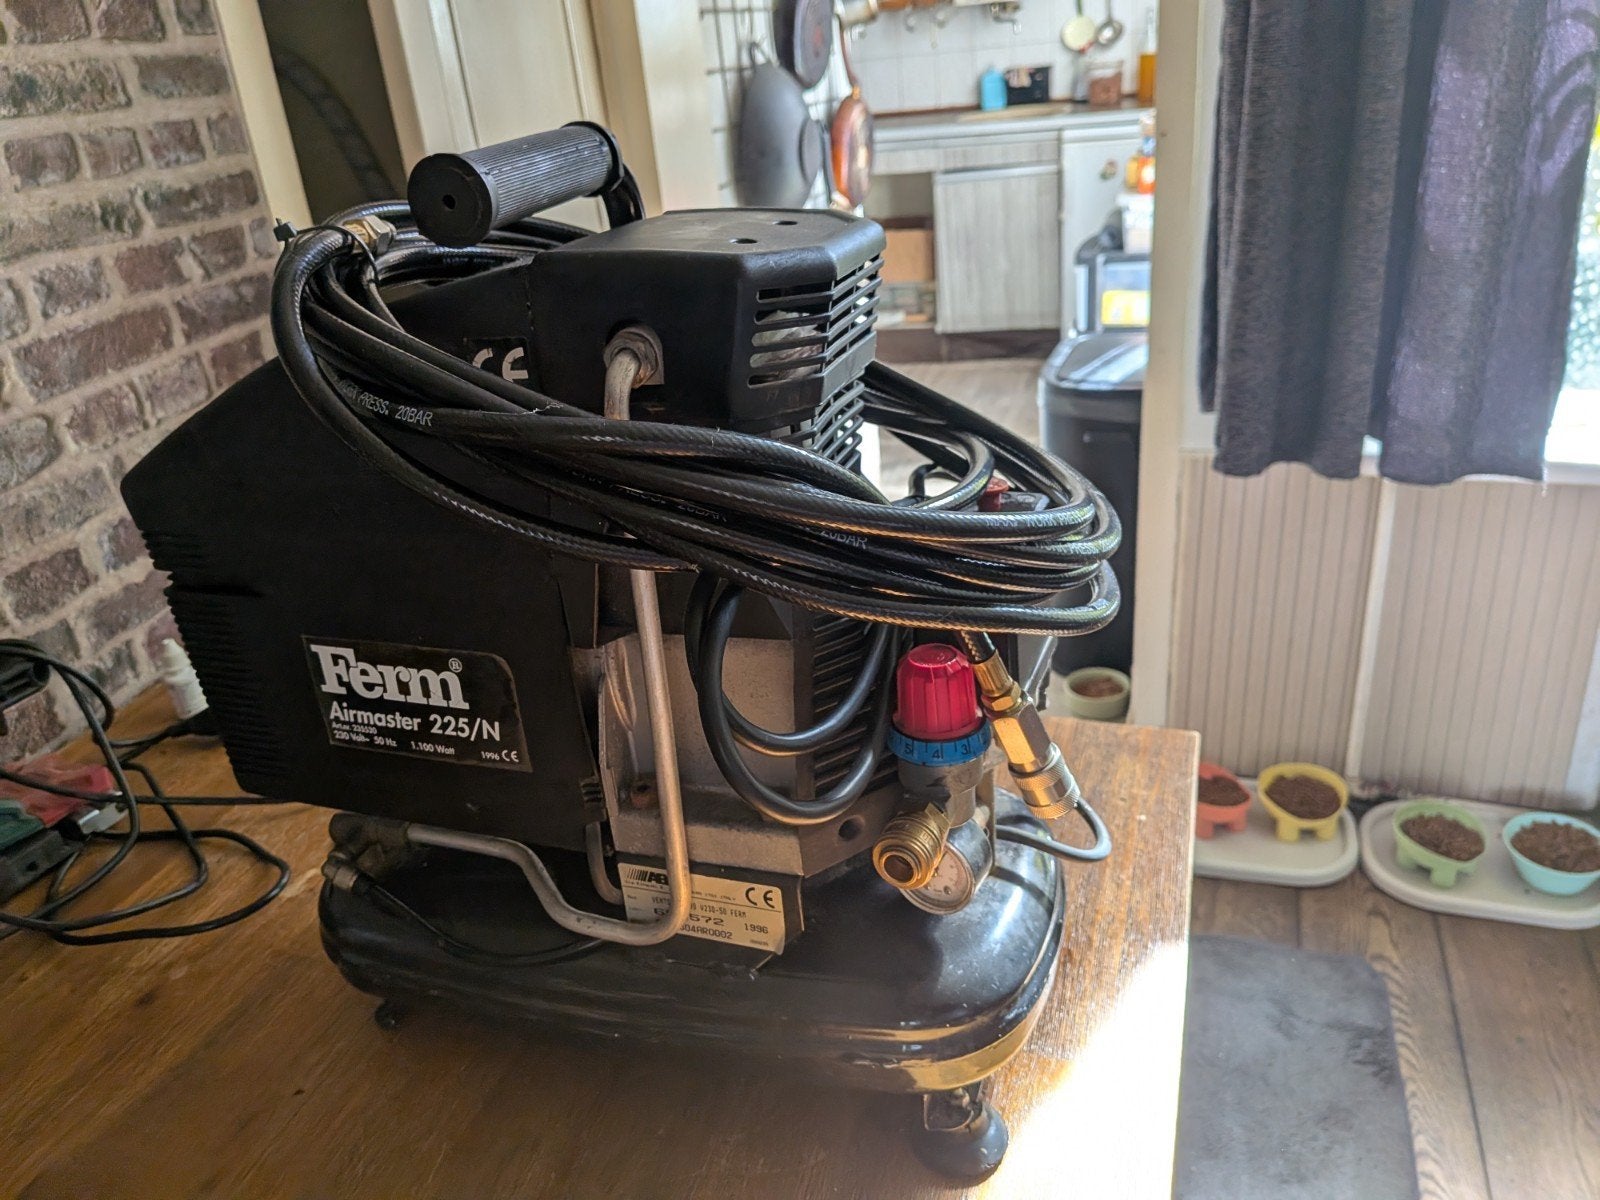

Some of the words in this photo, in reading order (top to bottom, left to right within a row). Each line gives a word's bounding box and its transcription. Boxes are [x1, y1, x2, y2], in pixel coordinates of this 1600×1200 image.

[395, 405, 433, 427] 20BAR
[310, 644, 470, 710] Ferm
[330, 701, 421, 731] Airmaster
[429, 714, 500, 742] 225/N
[435, 744, 455, 755] Watt
[481, 751, 500, 761] 1996
[904, 743, 912, 754] 5
[931, 749, 940, 760] 4
[961, 744, 968, 755] 3
[744, 923, 769, 934] 1996
